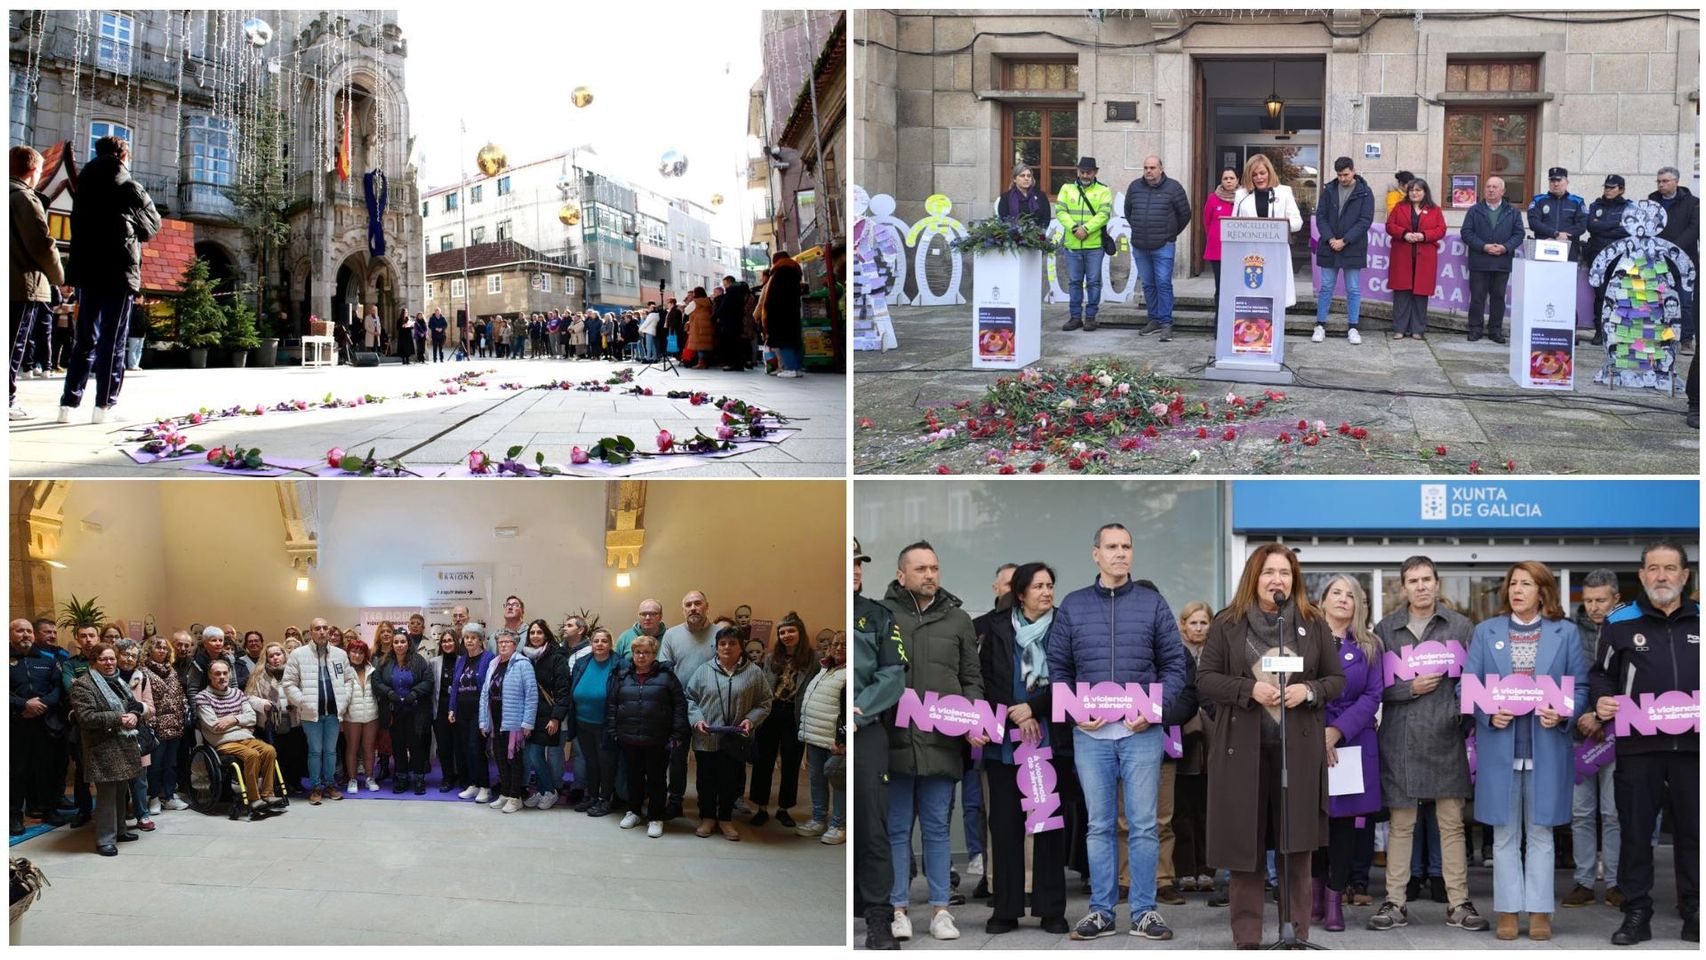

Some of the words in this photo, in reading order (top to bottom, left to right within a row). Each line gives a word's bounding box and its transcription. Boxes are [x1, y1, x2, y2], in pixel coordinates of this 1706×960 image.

[1227, 231, 1281, 239] REDONDELA
[1452, 487, 1508, 501] XUNTA
[1452, 503, 1472, 517] DE
[1477, 503, 1542, 517] GALICIA
[1414, 652, 1456, 661] violencia
[1408, 660, 1420, 668] de
[1461, 673, 1575, 717] NON
[1492, 693, 1505, 701] de
[1506, 694, 1543, 702] xénero
[1499, 687, 1544, 696] violencia
[1052, 681, 1163, 724] NON
[1091, 695, 1133, 703] violencia
[895, 687, 1008, 744] NON
[929, 712, 942, 721] de
[943, 713, 979, 726] xénero
[937, 707, 981, 720] violencia
[1034, 763, 1047, 803] violencia
